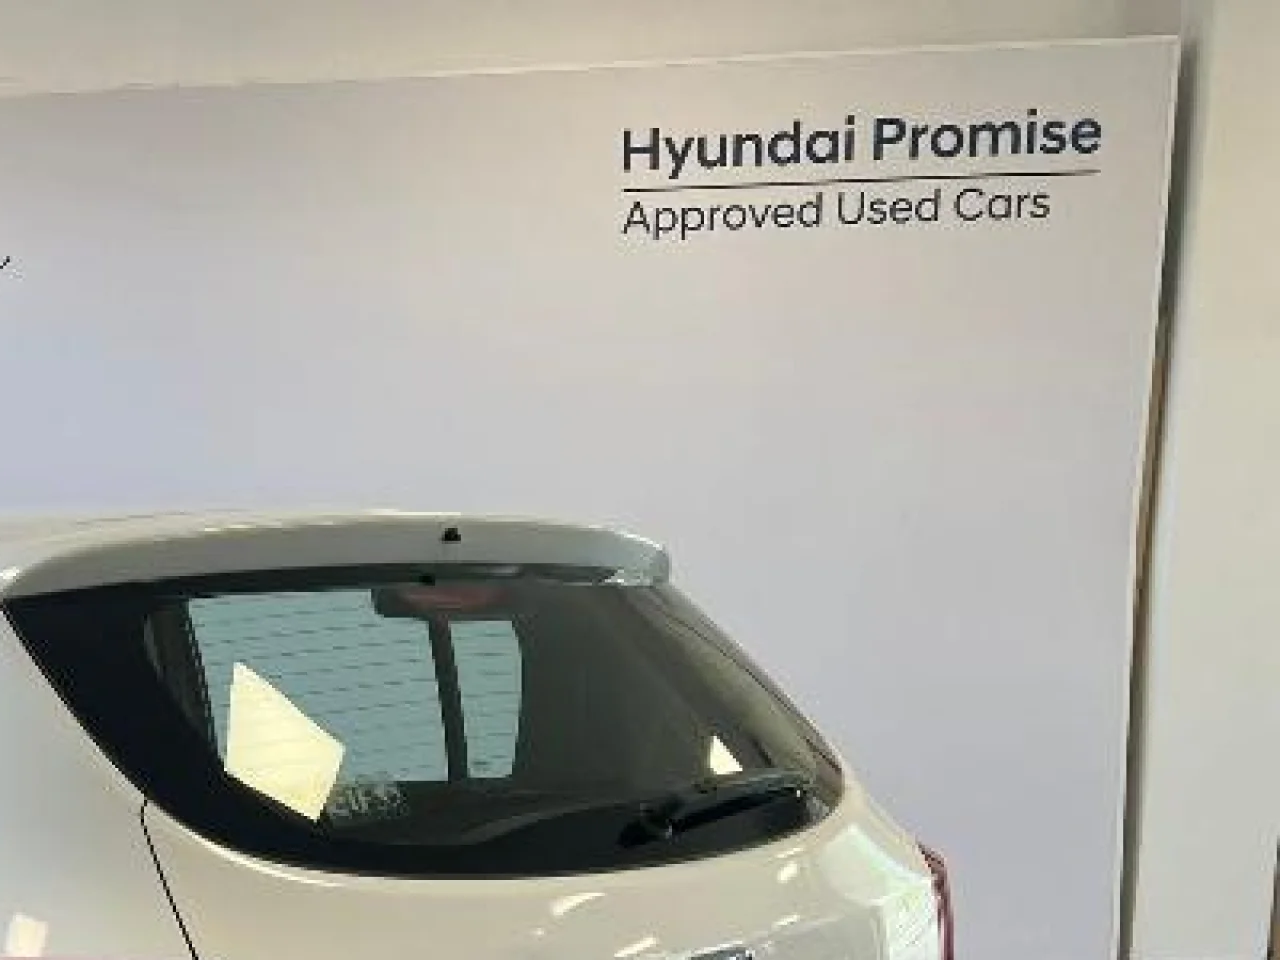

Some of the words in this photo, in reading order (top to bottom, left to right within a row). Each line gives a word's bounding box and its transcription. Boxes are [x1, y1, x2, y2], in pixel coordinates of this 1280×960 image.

[622, 114, 856, 180] Hyundai
[872, 108, 1102, 161] Promise
[621, 191, 823, 240] Approved
[837, 188, 942, 225] Used
[953, 188, 1052, 220] Cars
